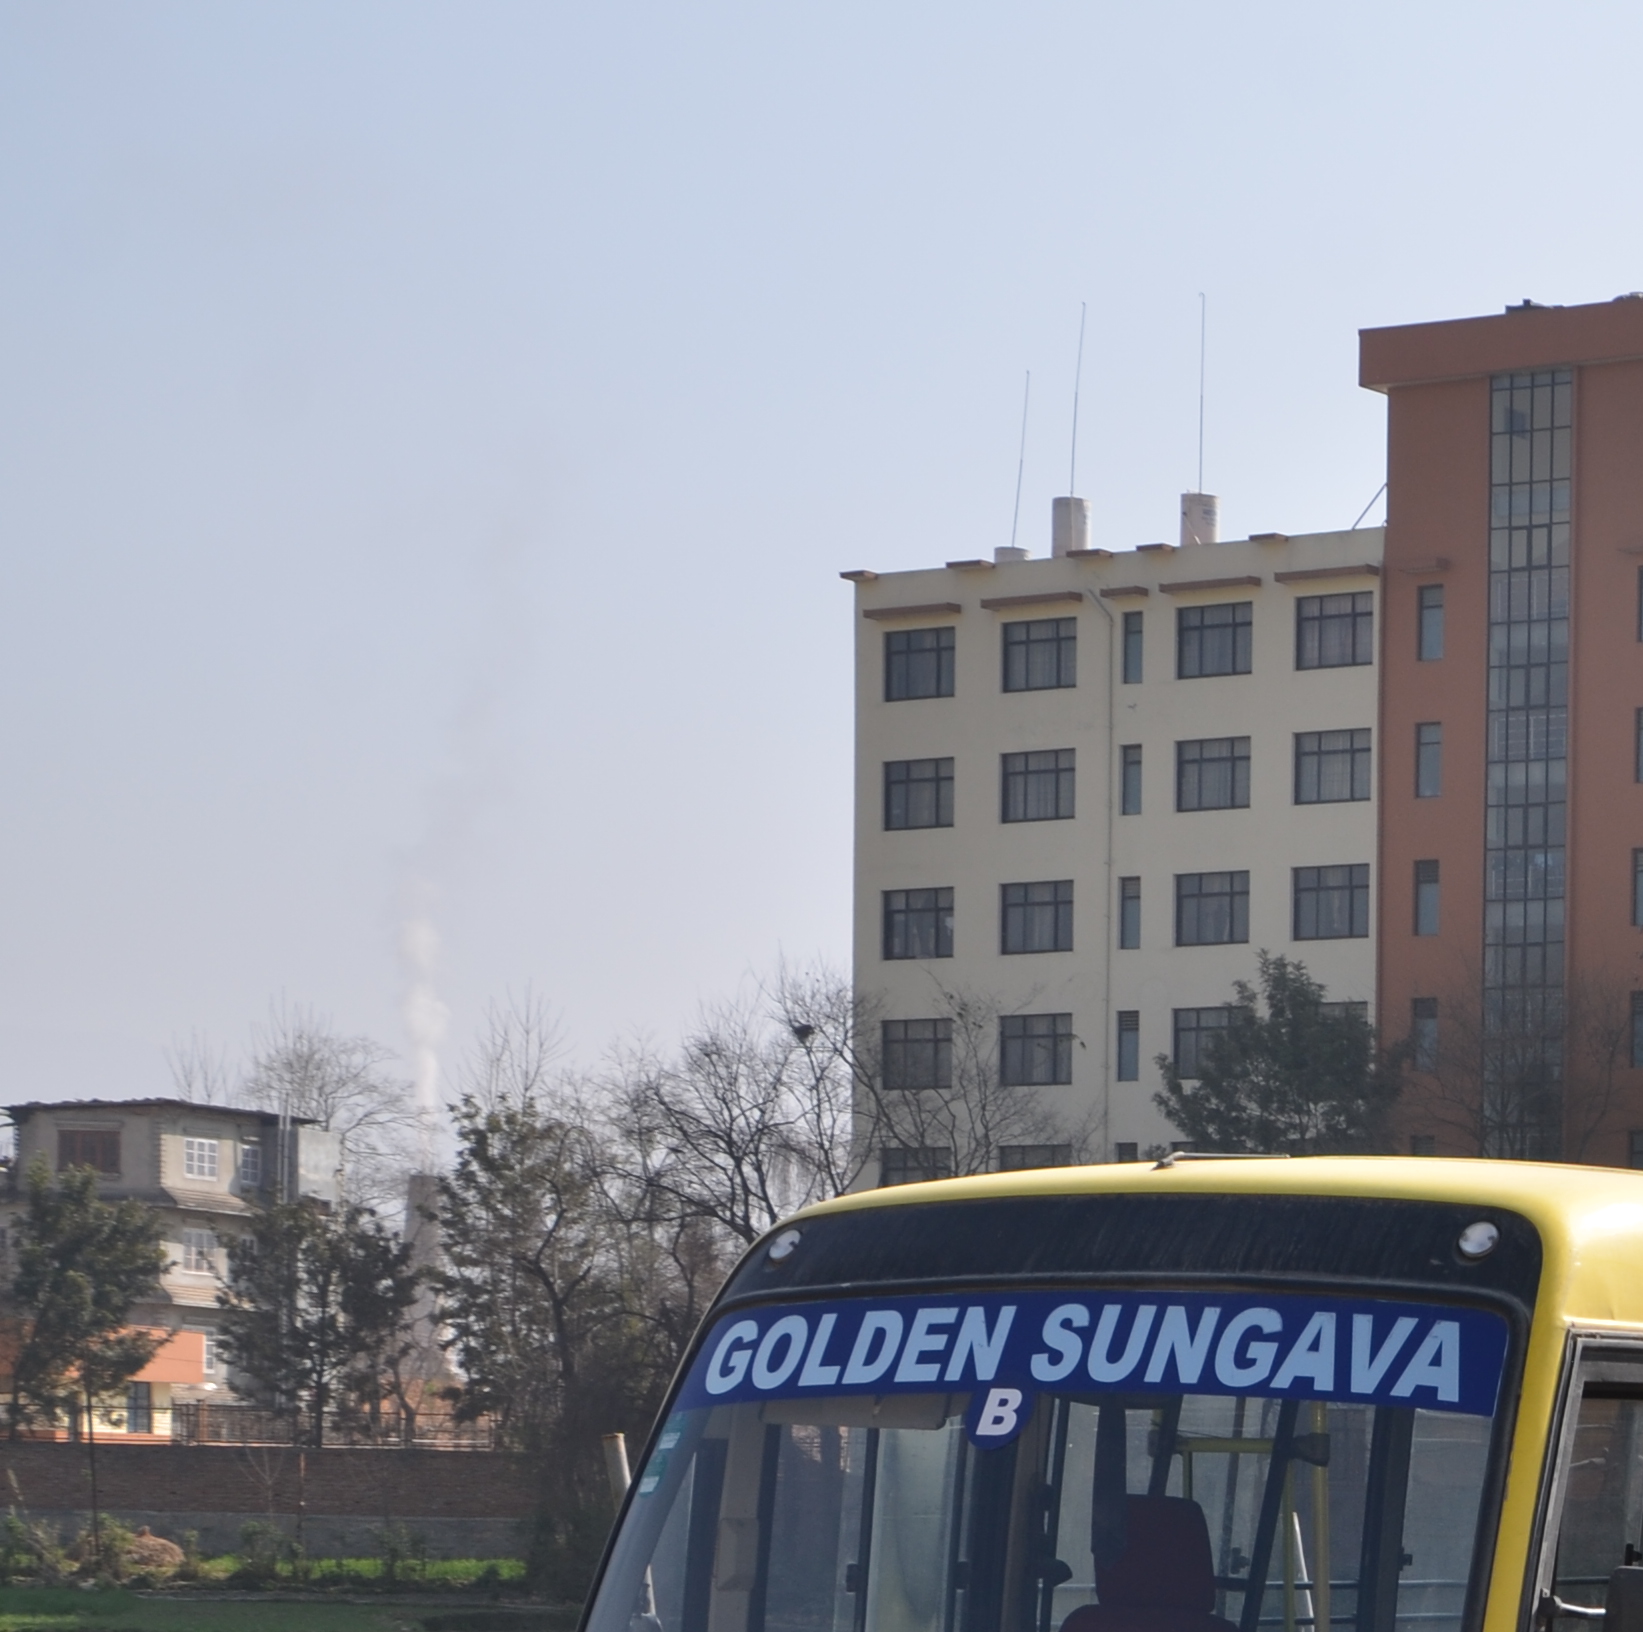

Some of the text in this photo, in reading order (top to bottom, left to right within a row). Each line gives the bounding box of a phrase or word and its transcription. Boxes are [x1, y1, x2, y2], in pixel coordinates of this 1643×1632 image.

[705, 1303, 1461, 1403] GOLDEN SUNGAVA
[976, 1388, 1023, 1436] B
